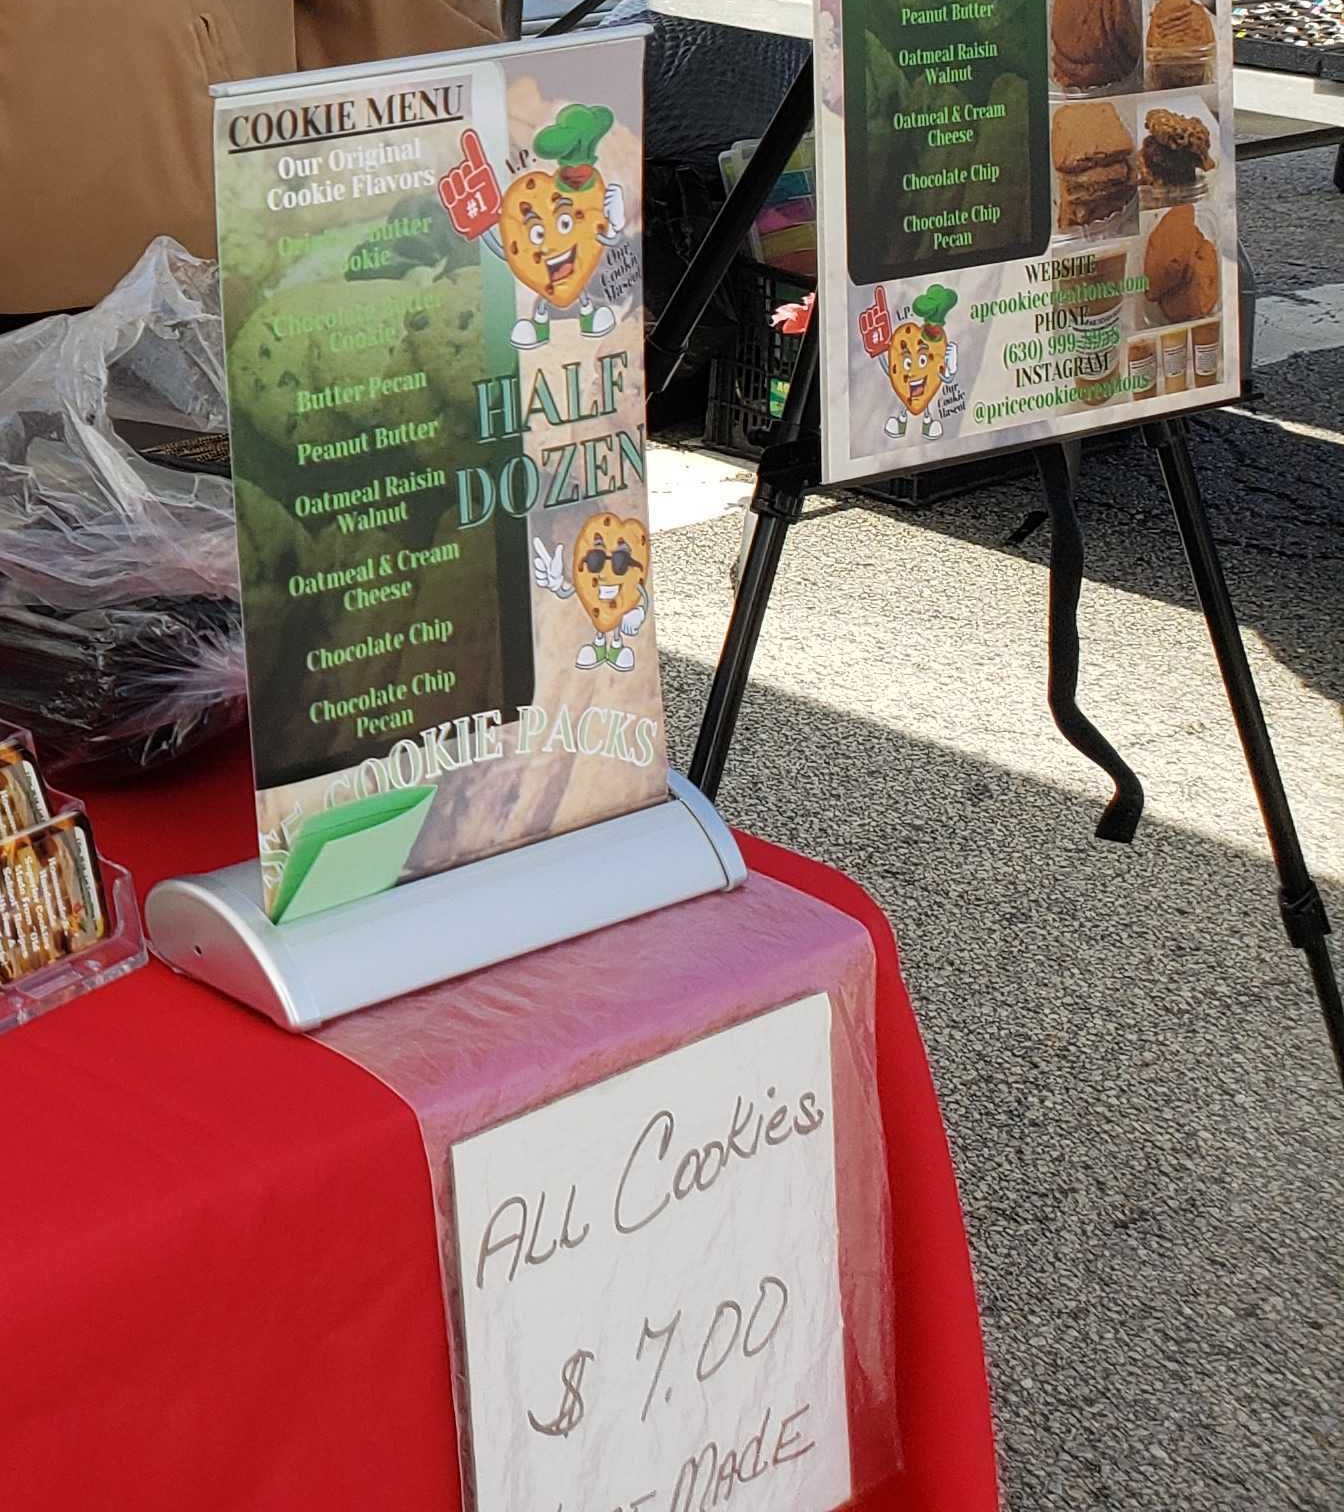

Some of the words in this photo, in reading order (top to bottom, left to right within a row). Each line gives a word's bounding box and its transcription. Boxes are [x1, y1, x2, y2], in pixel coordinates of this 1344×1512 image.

[901, 7, 947, 26] Peanut
[952, 1, 994, 21] Butter
[899, 45, 954, 68] Oatmeal
[957, 40, 998, 62] Raisin
[925, 65, 973, 86] Walnut
[228, 96, 357, 149] COOKIE
[366, 85, 464, 130] MENU
[893, 106, 948, 131] Oatmeal
[951, 105, 961, 122] &
[964, 101, 1006, 122] Cream
[927, 127, 973, 148] Cheese
[278, 151, 323, 180] Our
[328, 137, 423, 175] Original
[267, 182, 346, 212] Cookie
[351, 163, 437, 200] Flavors
[902, 169, 966, 193] Chocolate
[969, 162, 1000, 185] Chip
[465, 193, 488, 219] #1
[903, 210, 967, 235] Chocolate
[970, 204, 1001, 227] Chip
[933, 230, 972, 250] Pecan
[1025, 254, 1096, 284] WEBSITE
[872, 328, 885, 344] #1
[1034, 306, 1090, 335] PHONE
[1002, 340, 1044, 371] (630)
[1015, 353, 1110, 389] INSTAGRAM
[296, 379, 370, 413] Butter
[371, 368, 428, 402] Pecan
[472, 349, 631, 445] HALF
[936, 391, 966, 405] Cookie
[941, 384, 959, 394] Our
[297, 432, 370, 465] Peanut
[375, 417, 440, 450] Butter
[294, 482, 381, 518] Oatmeal
[385, 466, 446, 499] Raisin
[455, 424, 646, 530] DOZEN
[337, 500, 408, 536] Walnut
[288, 561, 375, 598] Oatmeal
[378, 555, 393, 576] &
[396, 540, 460, 573] Cream
[343, 577, 413, 613] Cheese
[306, 633, 404, 673] Chocolate
[409, 618, 454, 646] Chip
[309, 685, 407, 725] Chocolate
[411, 668, 457, 699] Chip
[355, 707, 415, 739] Pecan
[323, 709, 504, 811] COOKIE
[515, 703, 657, 768] PACKS
[475, 1185, 590, 1290] ALL
[613, 1086, 826, 1235] Cookies
[527, 1348, 595, 1438] $
[635, 1275, 789, 1423] 7.00
